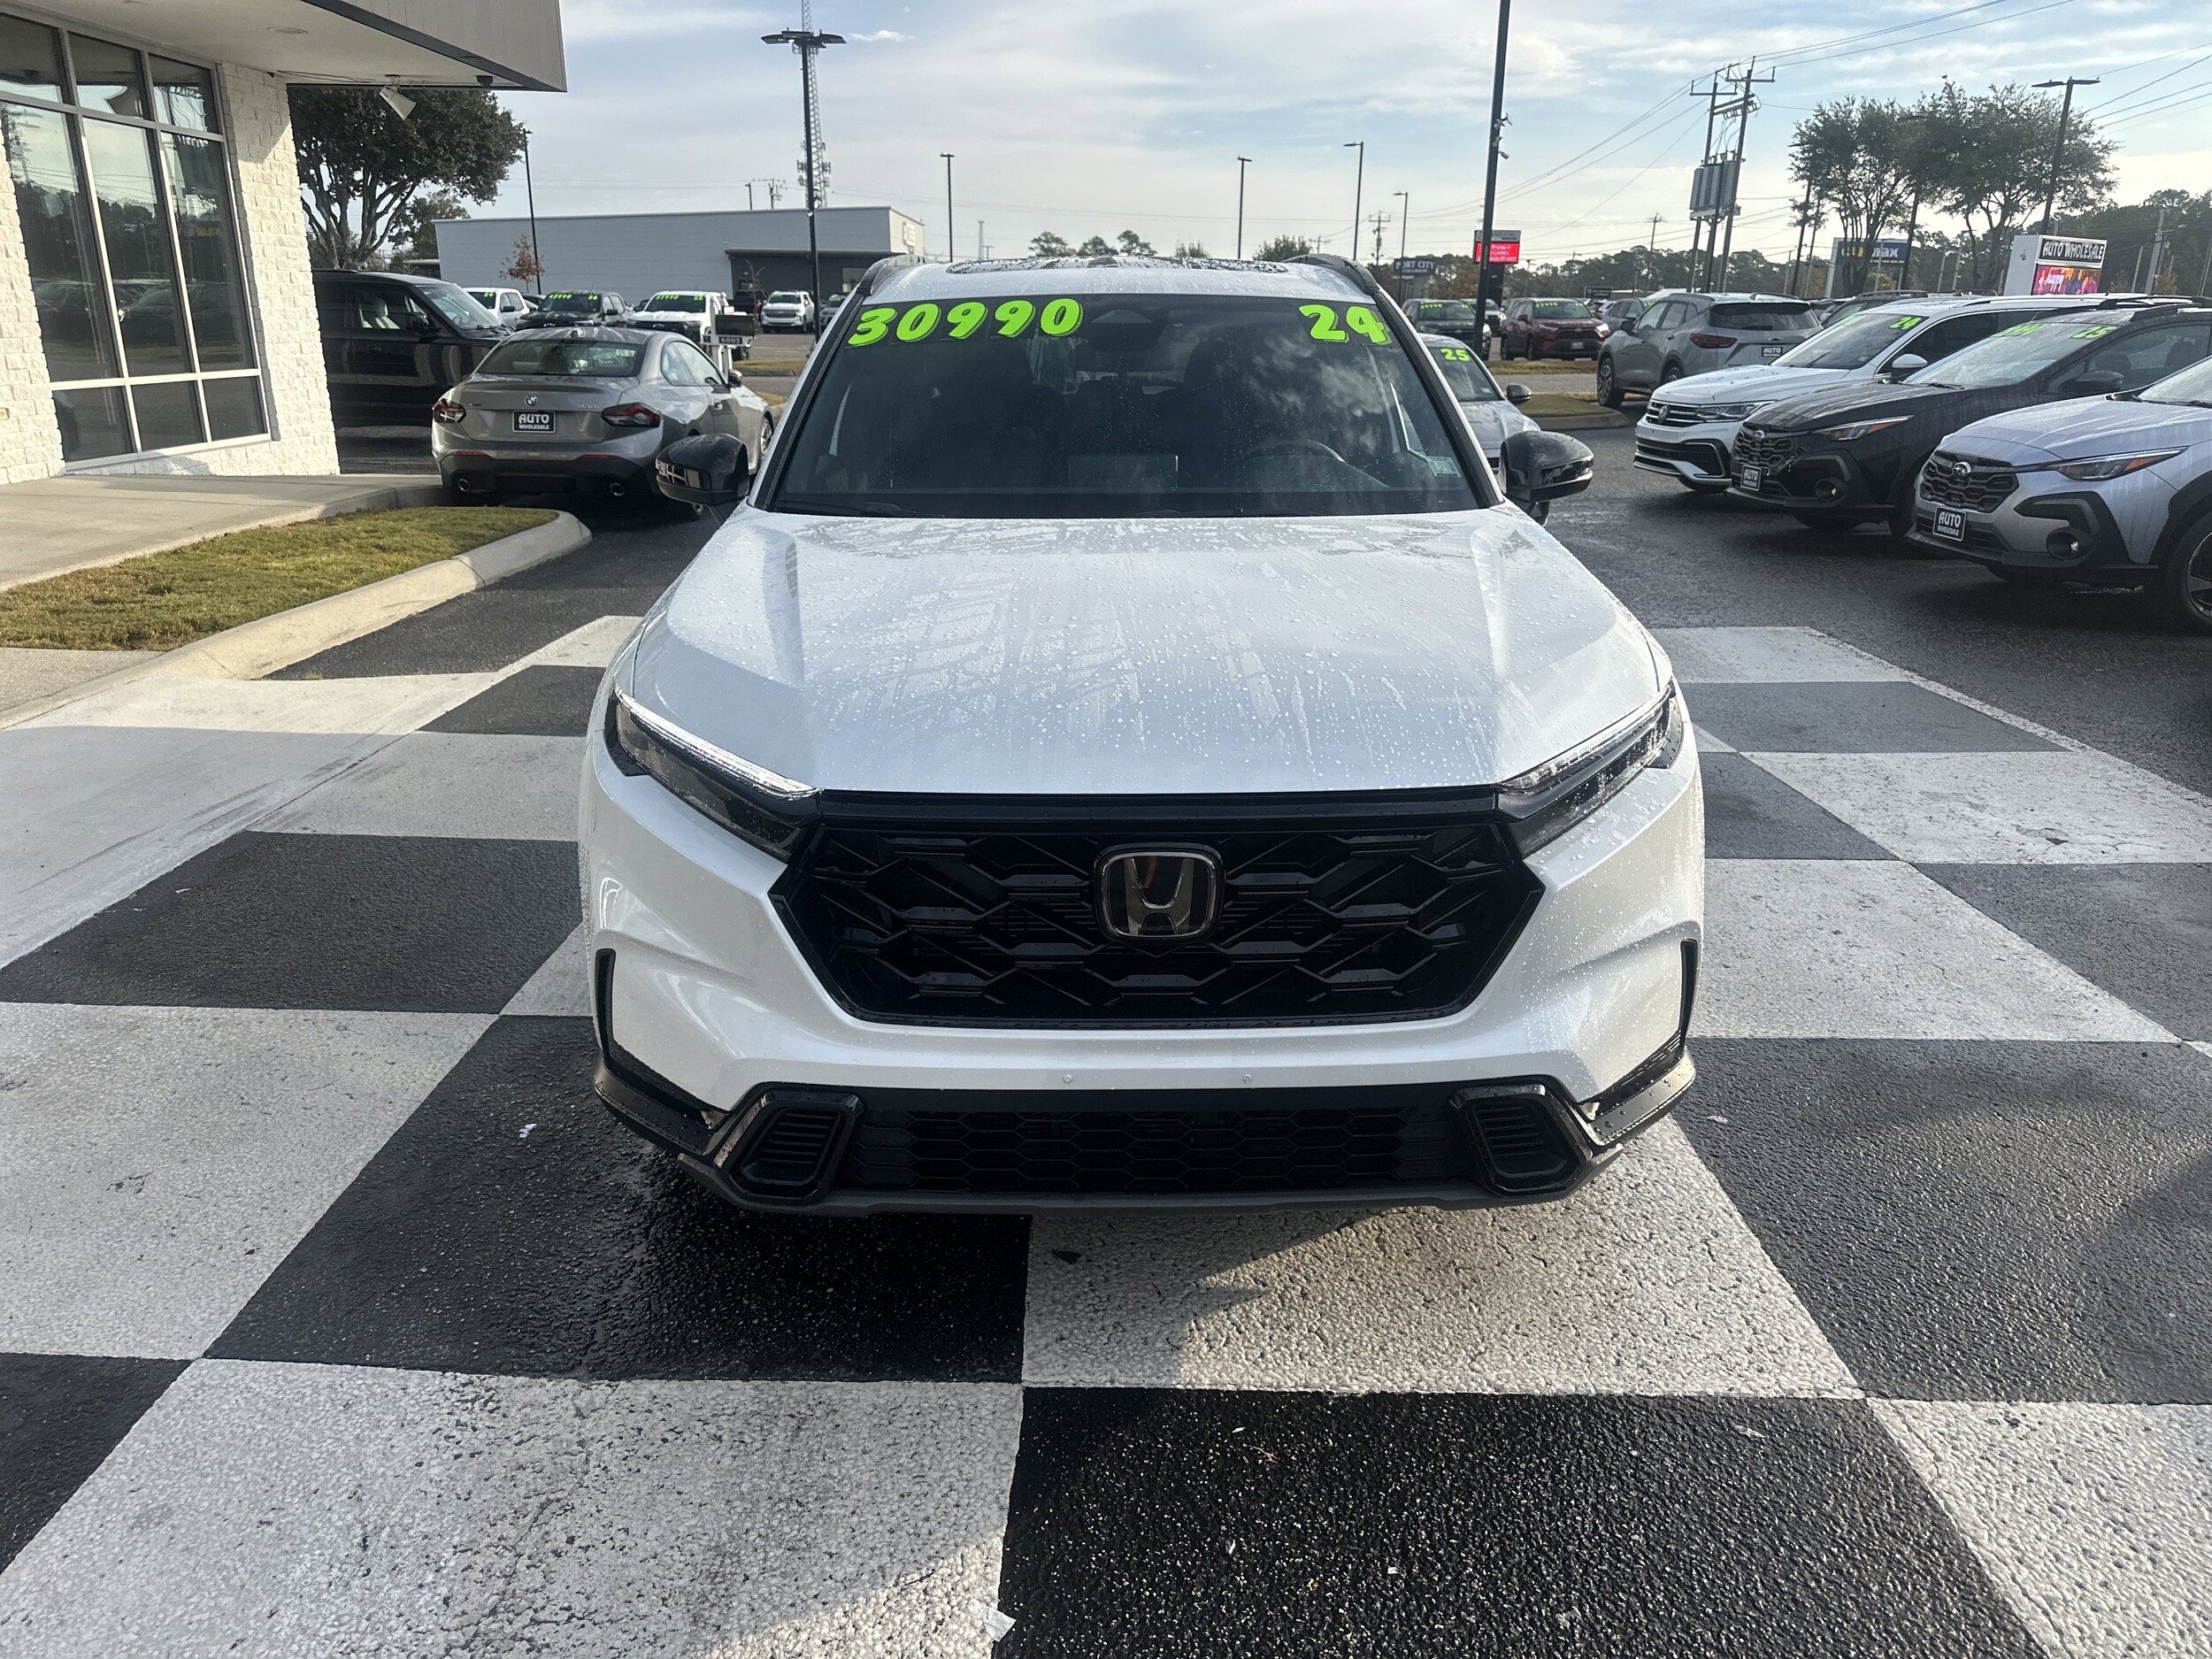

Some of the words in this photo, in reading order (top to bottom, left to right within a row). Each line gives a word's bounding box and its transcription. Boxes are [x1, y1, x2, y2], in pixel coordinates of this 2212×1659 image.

[2042, 241, 2063, 257] AUTO
[2064, 242, 2104, 260] WHOLESALE
[1417, 260, 1434, 269] CITY
[848, 298, 1085, 347] 30990
[1298, 303, 1394, 346] 24
[2071, 326, 2118, 339] 25
[1440, 348, 1471, 362] 25
[518, 413, 549, 424] AUTO
[1744, 468, 1758, 481] AUTO
[1938, 511, 1962, 528] AUTO
[1937, 525, 1960, 536] WHOLESALE
